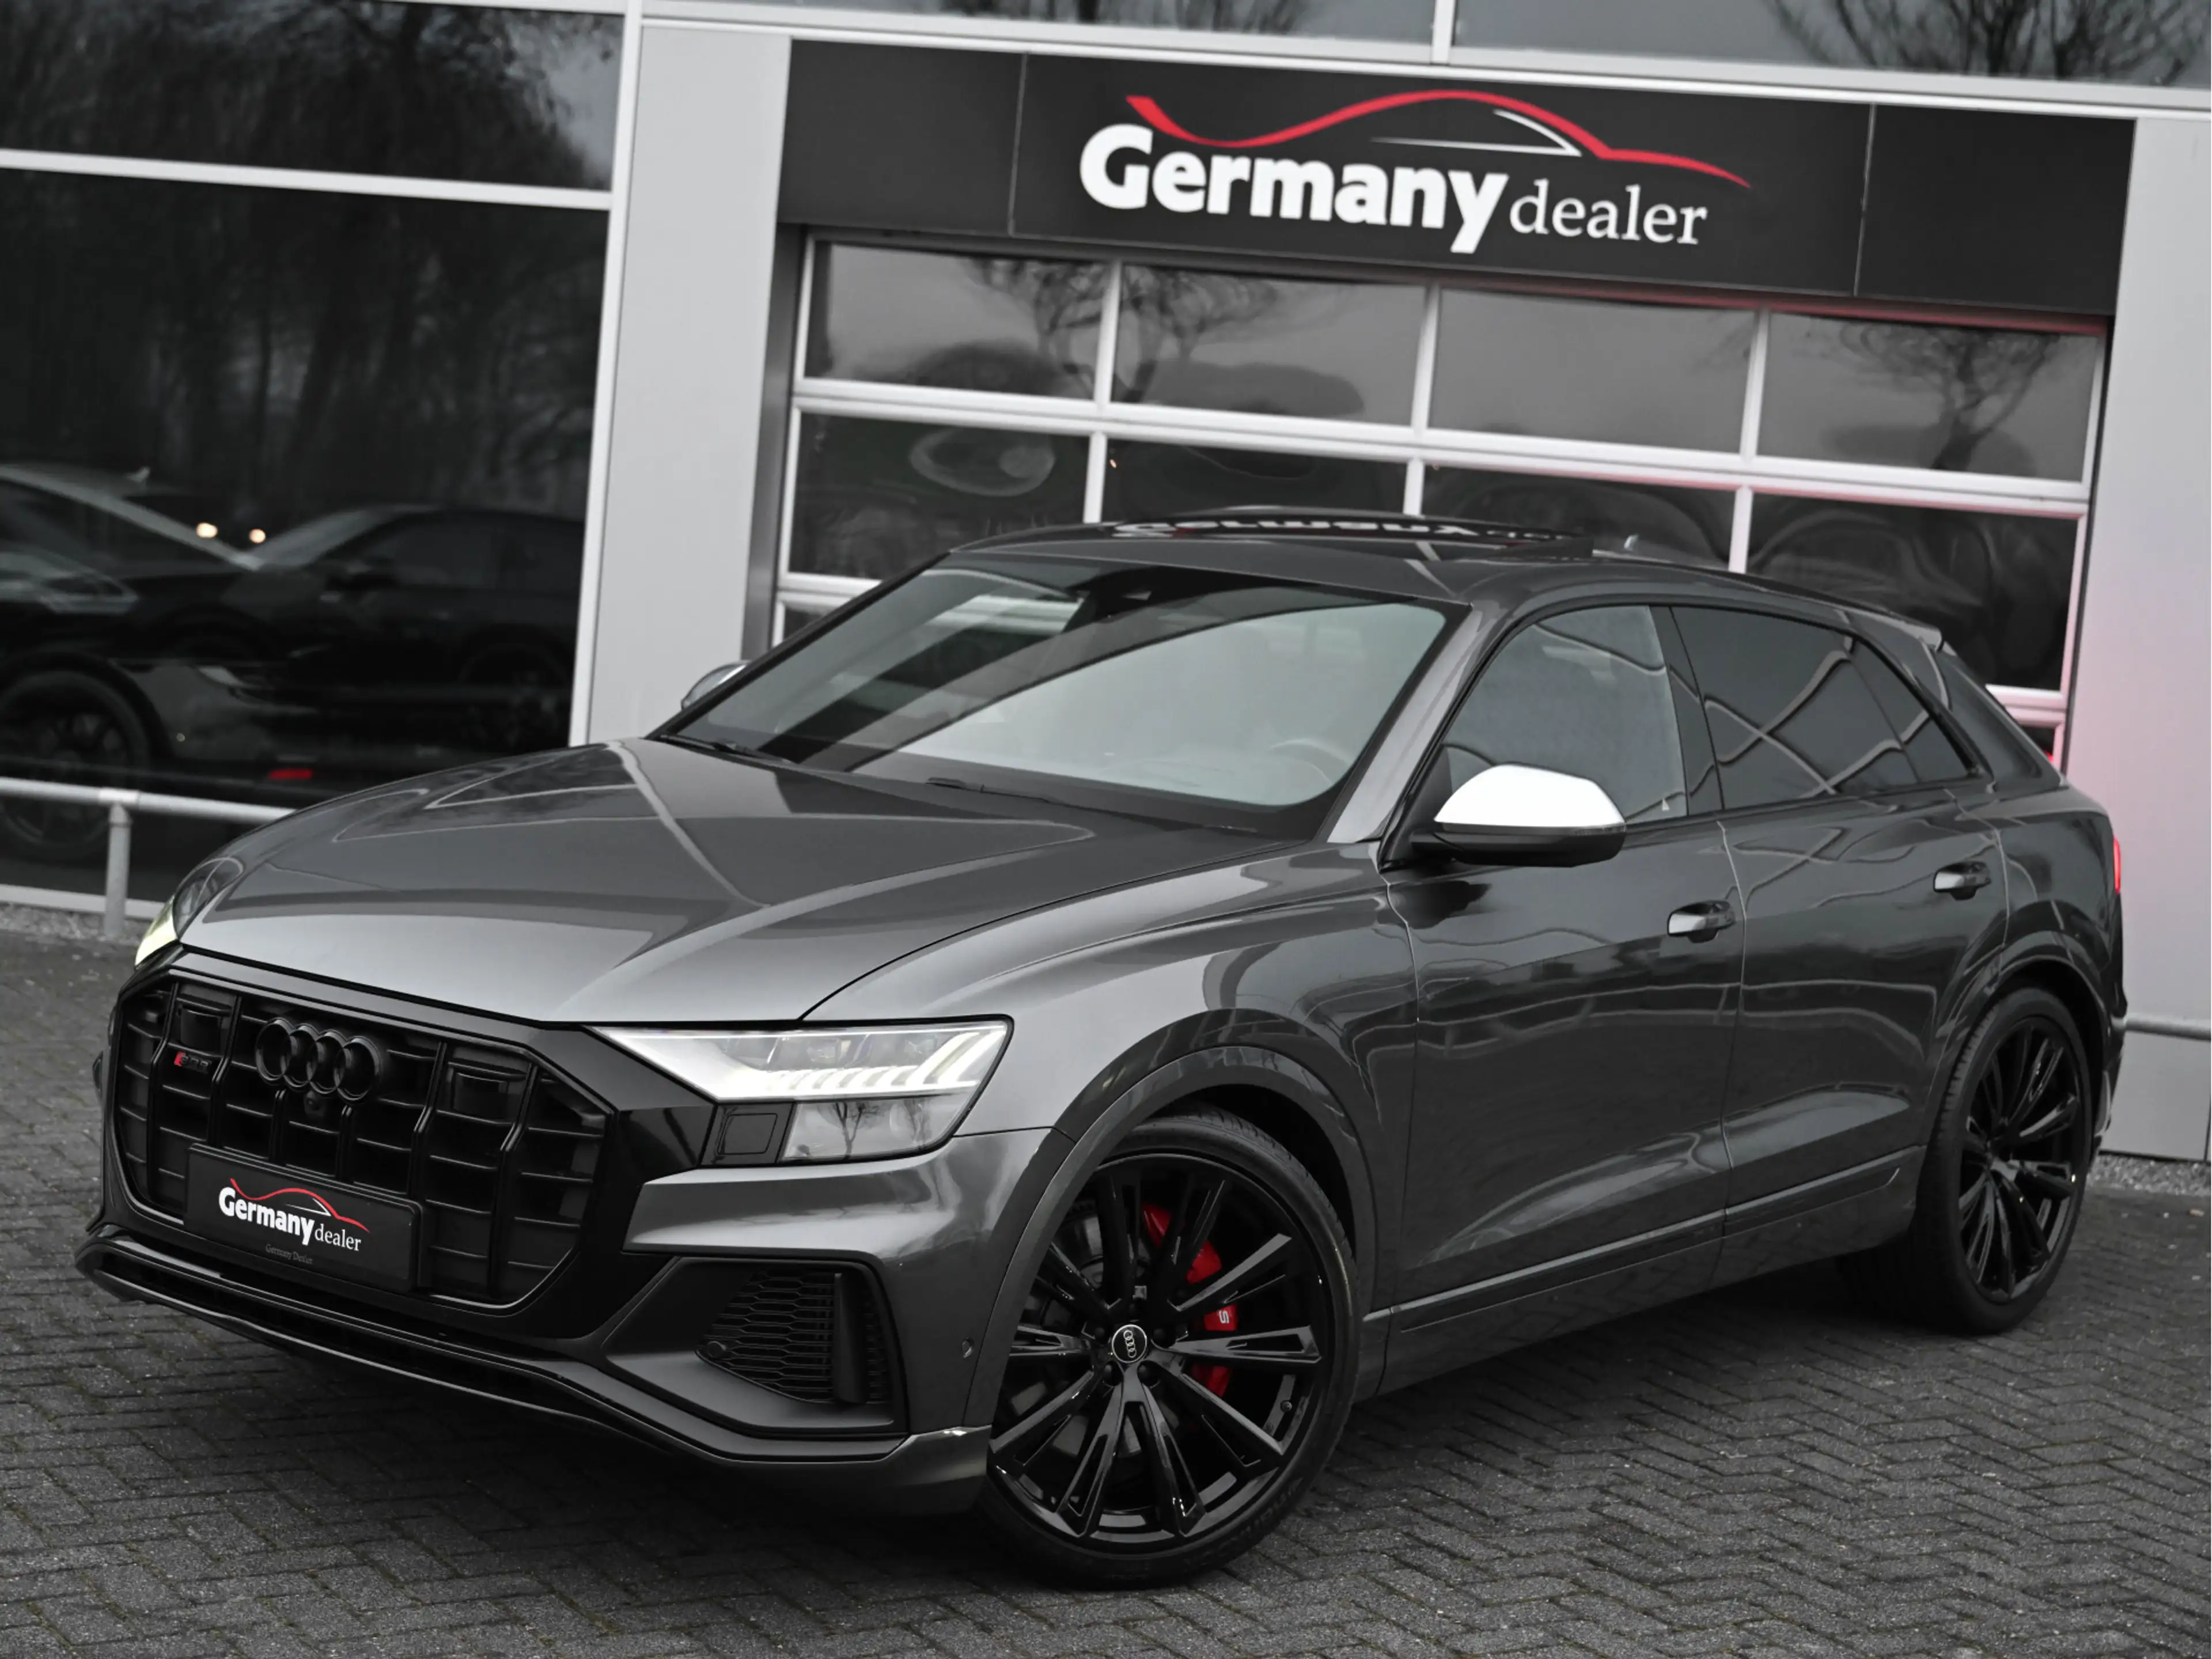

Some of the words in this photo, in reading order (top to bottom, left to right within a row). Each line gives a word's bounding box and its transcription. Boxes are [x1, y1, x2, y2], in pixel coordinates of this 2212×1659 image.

[1080, 124, 1509, 254] Germany
[1510, 179, 1708, 244] dealer
[218, 1187, 315, 1246] Germany
[315, 1224, 362, 1252] dealer
[1218, 1310, 1230, 1324] S
